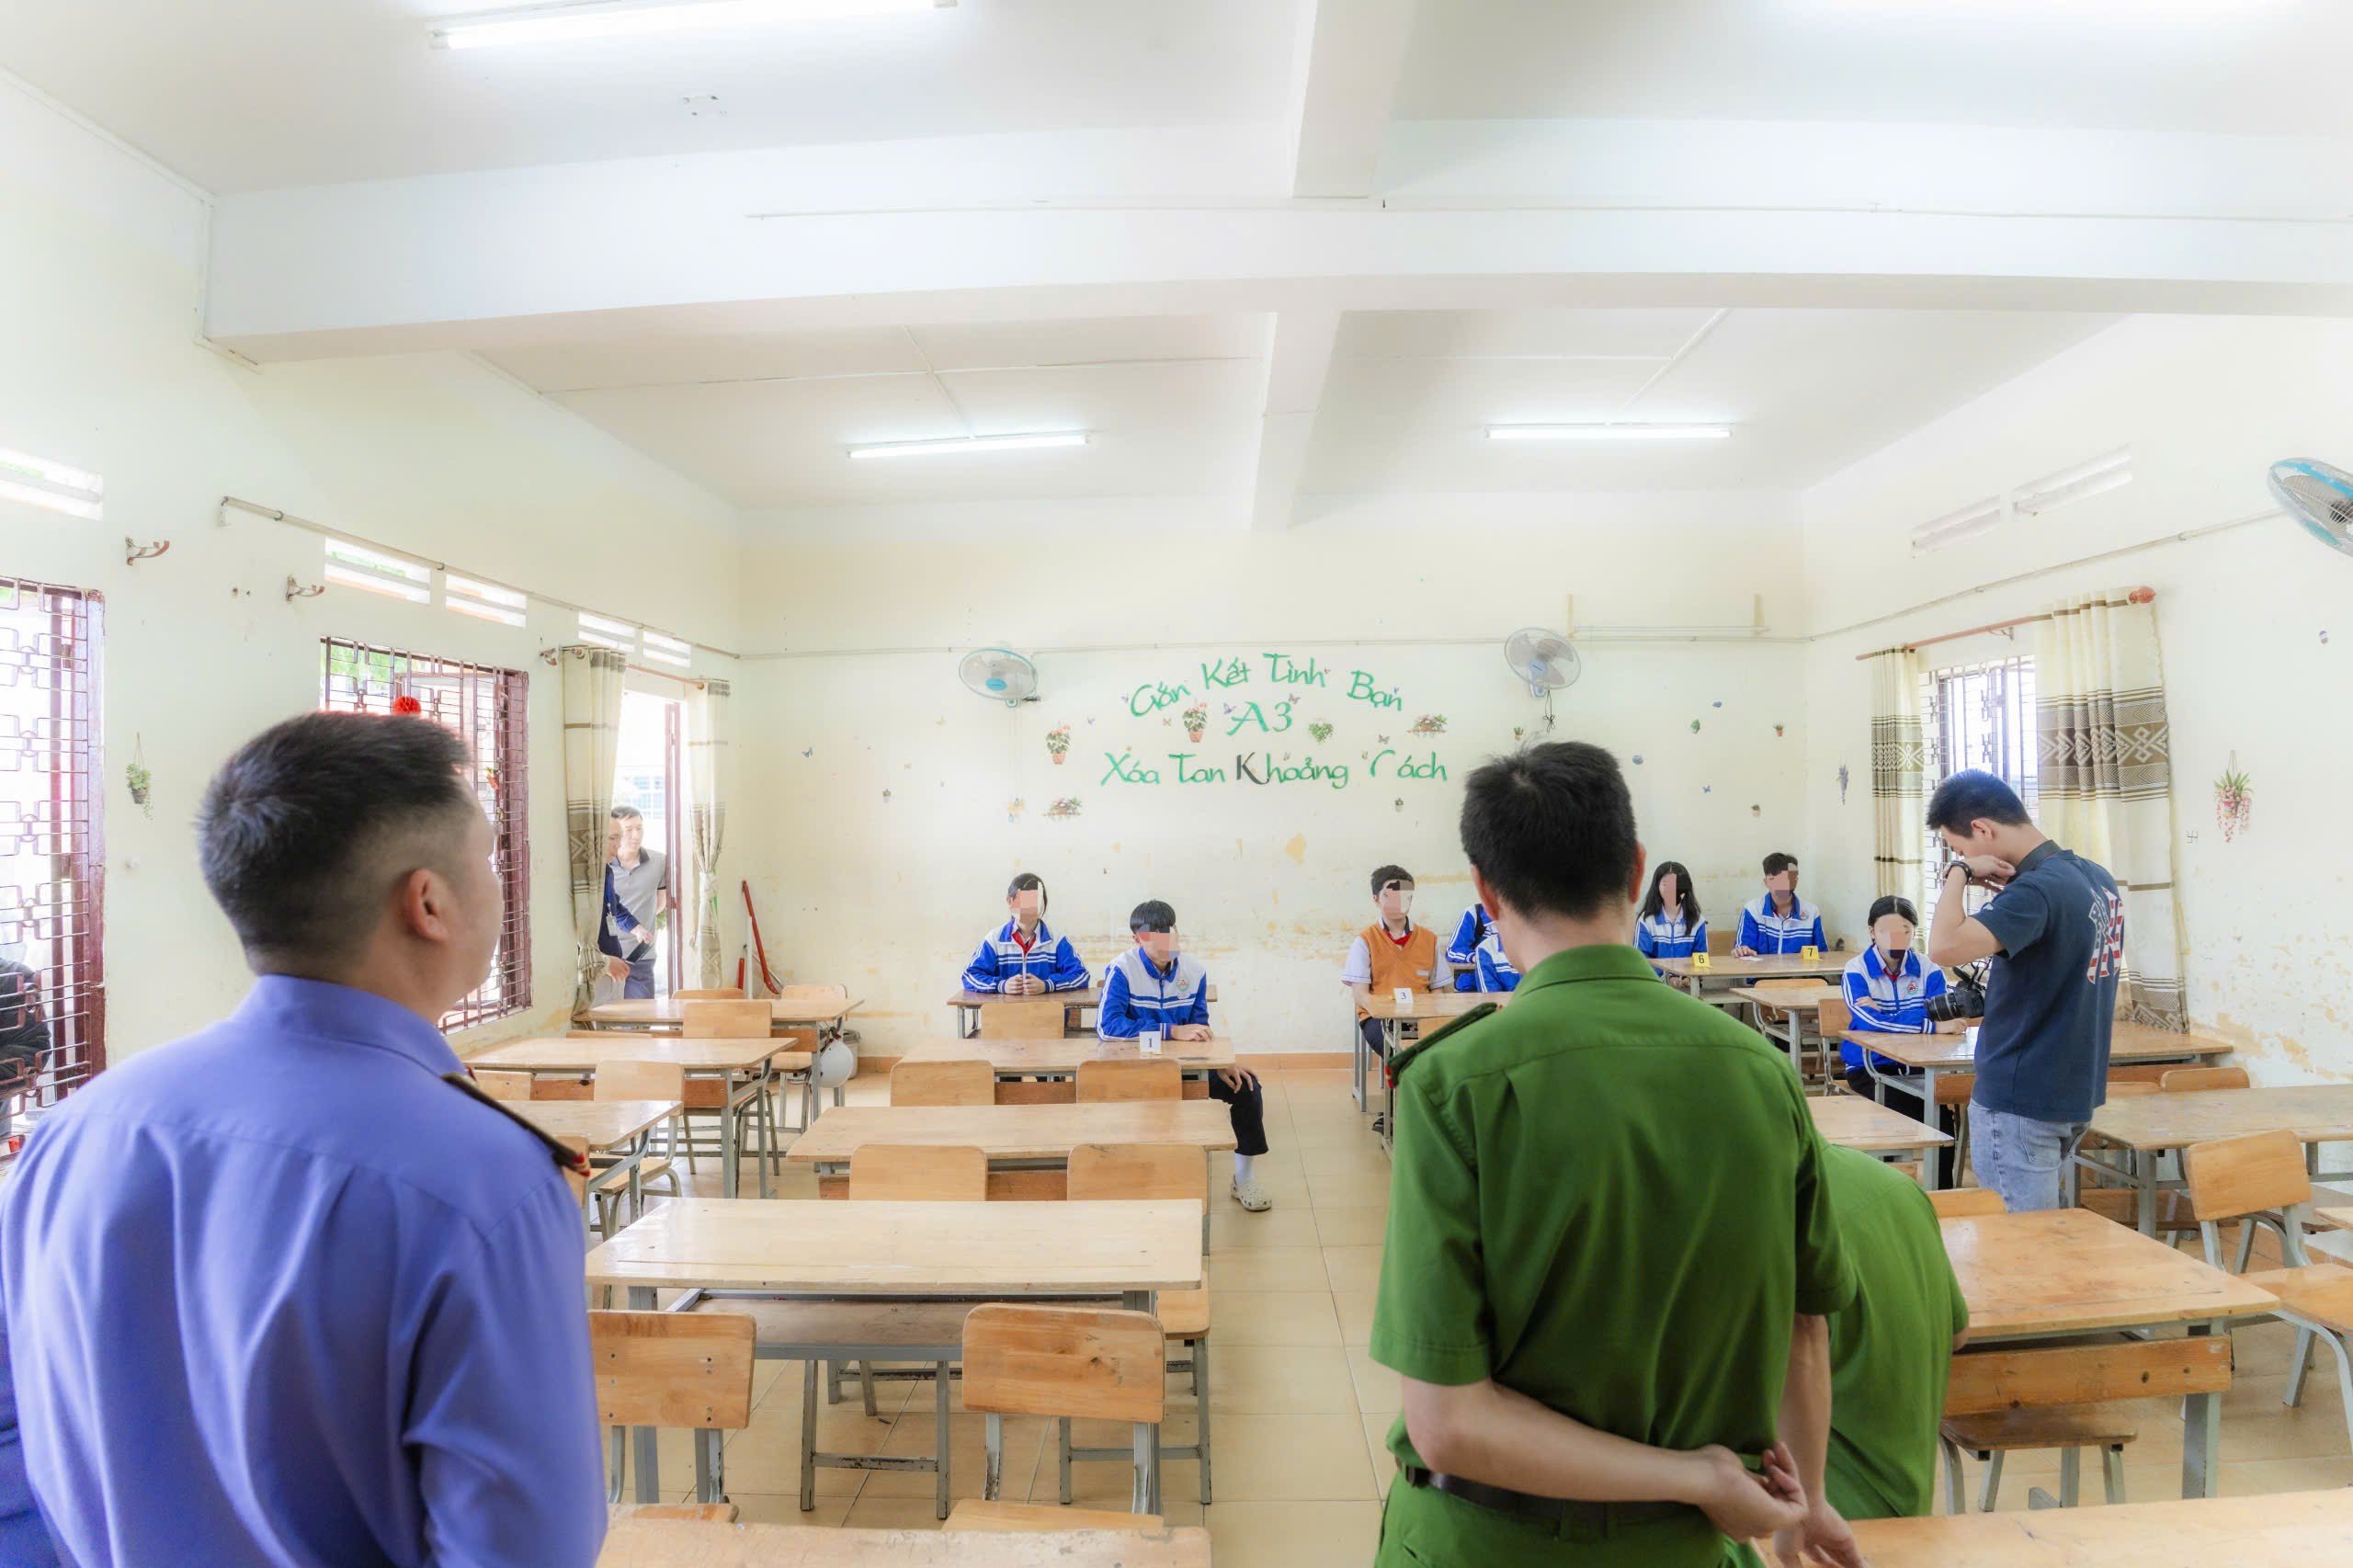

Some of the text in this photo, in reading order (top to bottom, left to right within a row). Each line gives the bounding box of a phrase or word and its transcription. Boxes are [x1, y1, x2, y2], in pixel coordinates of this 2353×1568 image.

[1201, 656, 1251, 689] Kết
[1262, 653, 1325, 687] Tình
[1347, 670, 1403, 711] Bạn
[1226, 701, 1292, 736] A3
[1100, 752, 1160, 786] Xóa
[1168, 753, 1225, 784] Tan
[1236, 751, 1348, 789] Khoảng
[1807, 948, 1813, 957] 7
[1698, 954, 1705, 964] 6
[1400, 992, 1407, 1000] 3
[1148, 1038, 1153, 1048] 1
